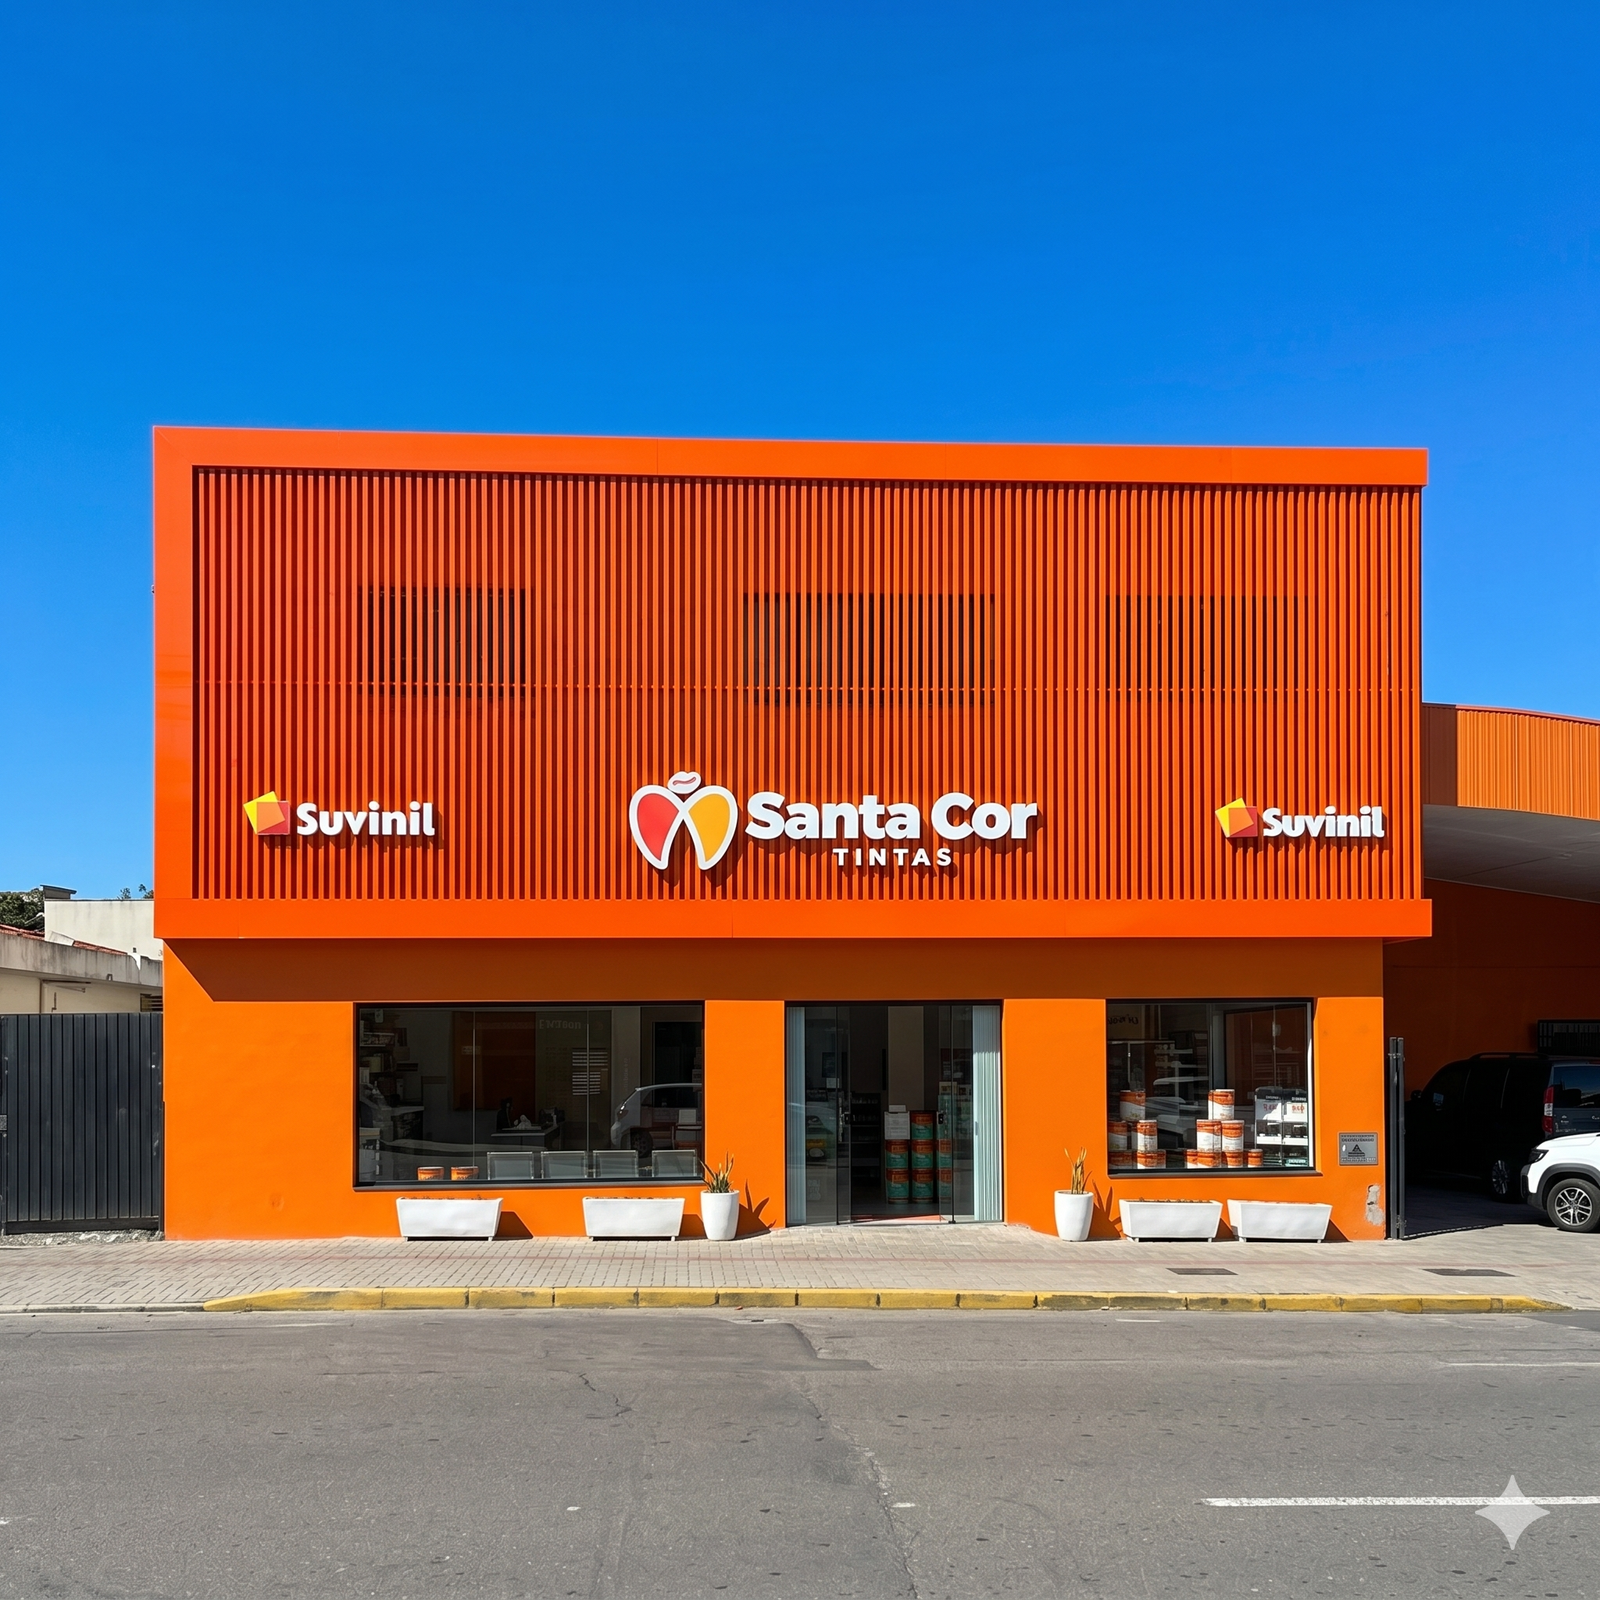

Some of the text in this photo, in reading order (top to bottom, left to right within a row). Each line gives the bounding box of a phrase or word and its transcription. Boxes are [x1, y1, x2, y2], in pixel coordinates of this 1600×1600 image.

[296, 800, 435, 836] Suvinil
[745, 791, 1038, 840] Santa Cor
[1262, 805, 1385, 838] Suvinil
[833, 847, 952, 866] TINTAS
